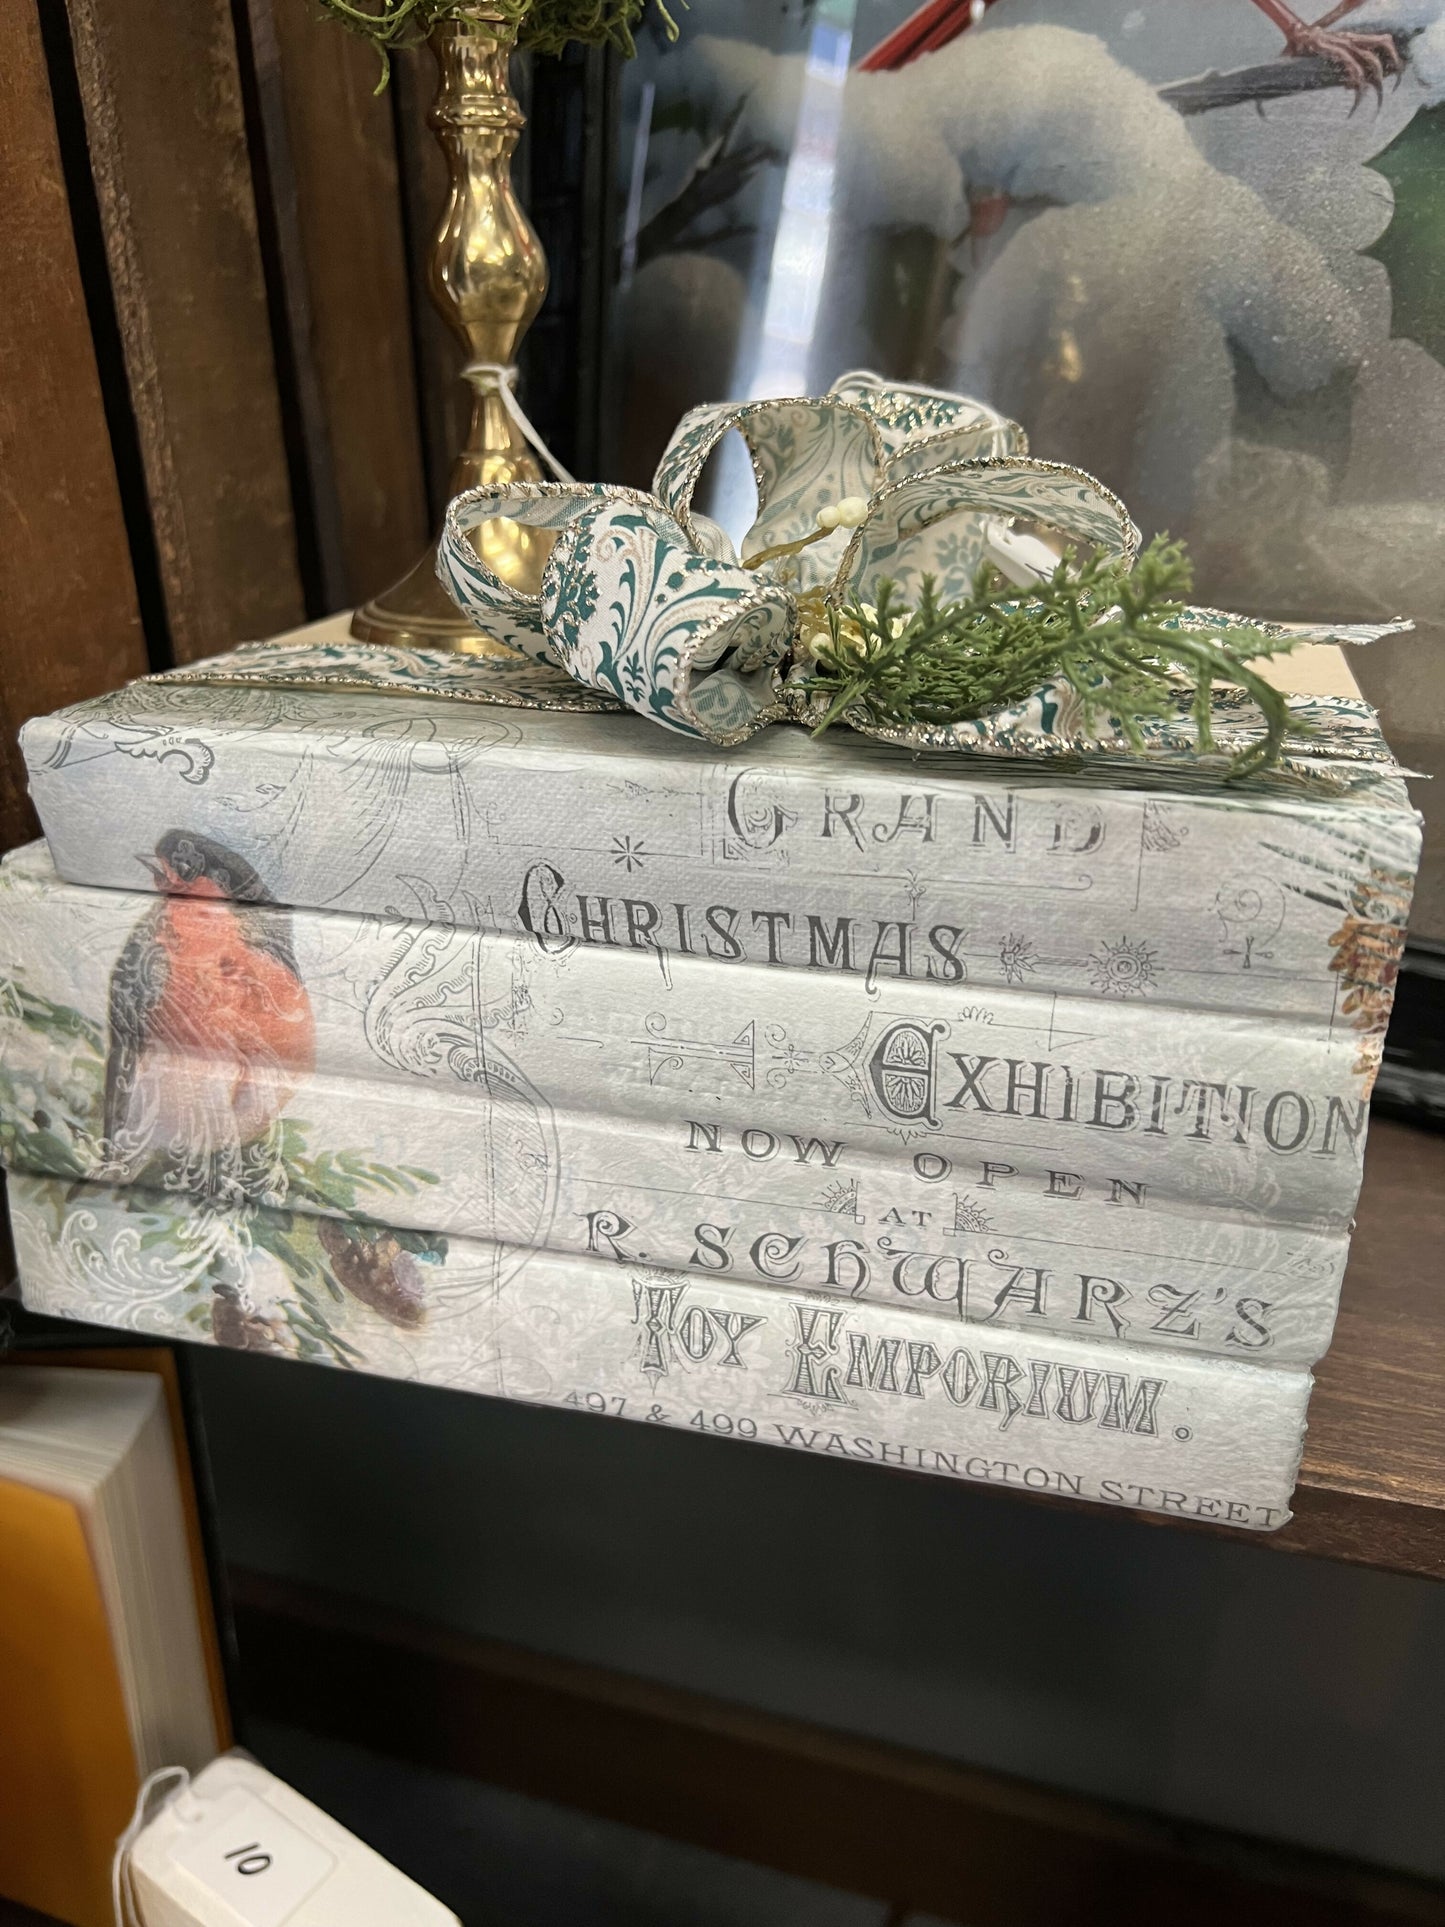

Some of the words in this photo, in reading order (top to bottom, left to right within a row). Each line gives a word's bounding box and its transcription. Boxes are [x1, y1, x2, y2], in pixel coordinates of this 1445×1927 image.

[726, 767, 1106, 858] GRAND
[517, 861, 968, 1000] CHRISTMAS
[869, 1018, 1370, 1160] EXHIBITION
[684, 1119, 848, 1168] NOW
[912, 1152, 1151, 1208] OPEN
[583, 1210, 651, 1262] R.
[880, 1207, 933, 1228] AT
[631, 1277, 768, 1376] TOY
[563, 1390, 627, 1416] 497
[645, 1404, 671, 1424] &
[690, 1409, 757, 1438] 499
[772, 1423, 1084, 1494] WASHINGTON
[1099, 1481, 1281, 1527] STREET
